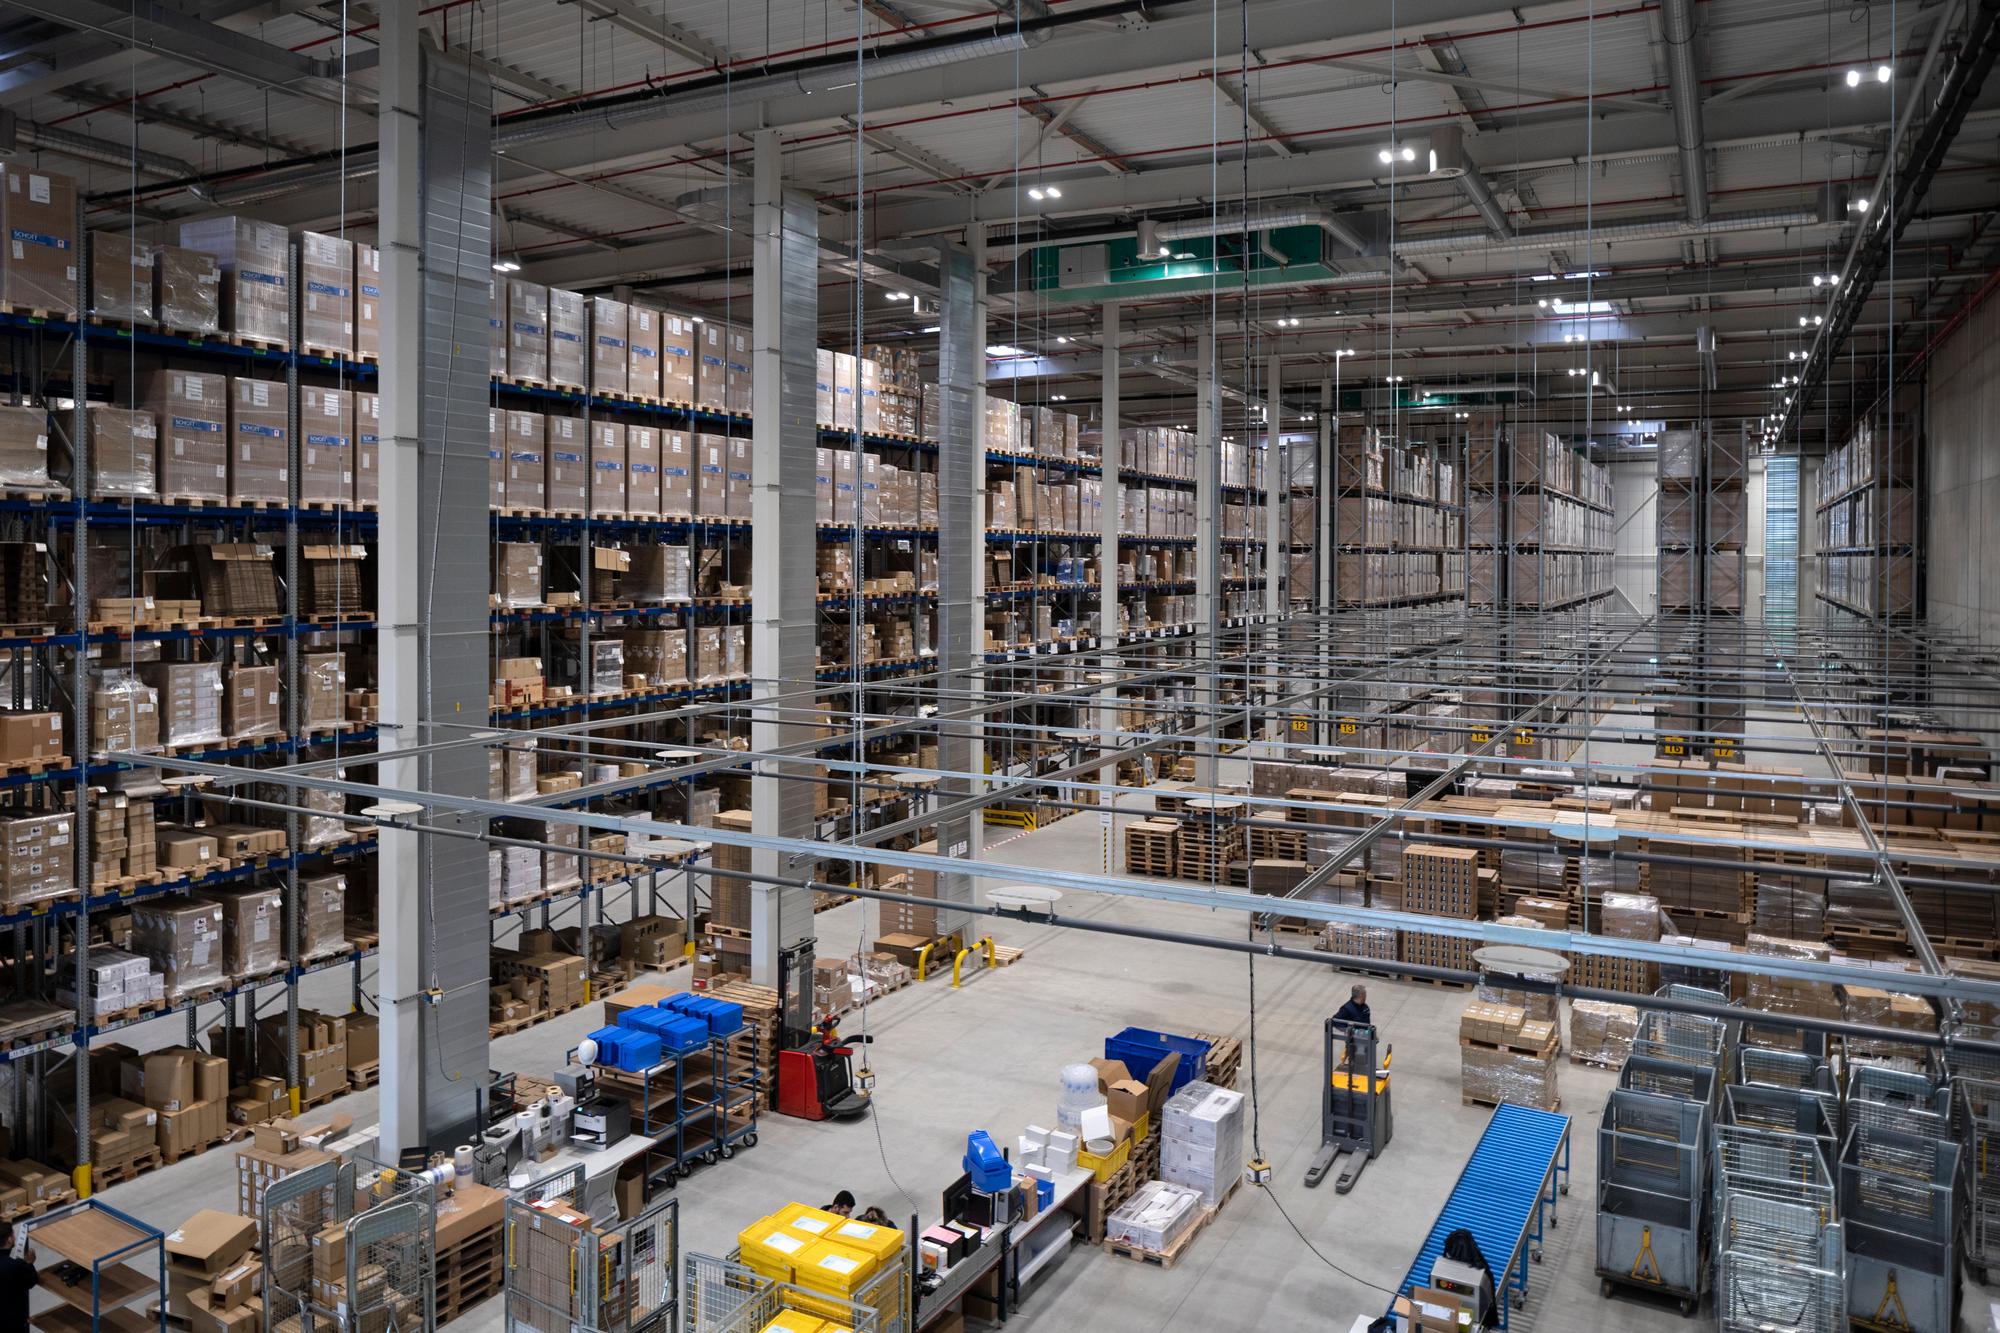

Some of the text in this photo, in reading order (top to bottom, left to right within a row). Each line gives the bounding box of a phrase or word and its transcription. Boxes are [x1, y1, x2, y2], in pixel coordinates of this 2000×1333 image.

[1295, 721, 1305, 730] 12
[1343, 724, 1354, 733] 13
[1476, 732, 1486, 741] 14
[1520, 735, 1531, 744] 15
[1669, 744, 1681, 753] 16
[1719, 747, 1730, 756] 17
